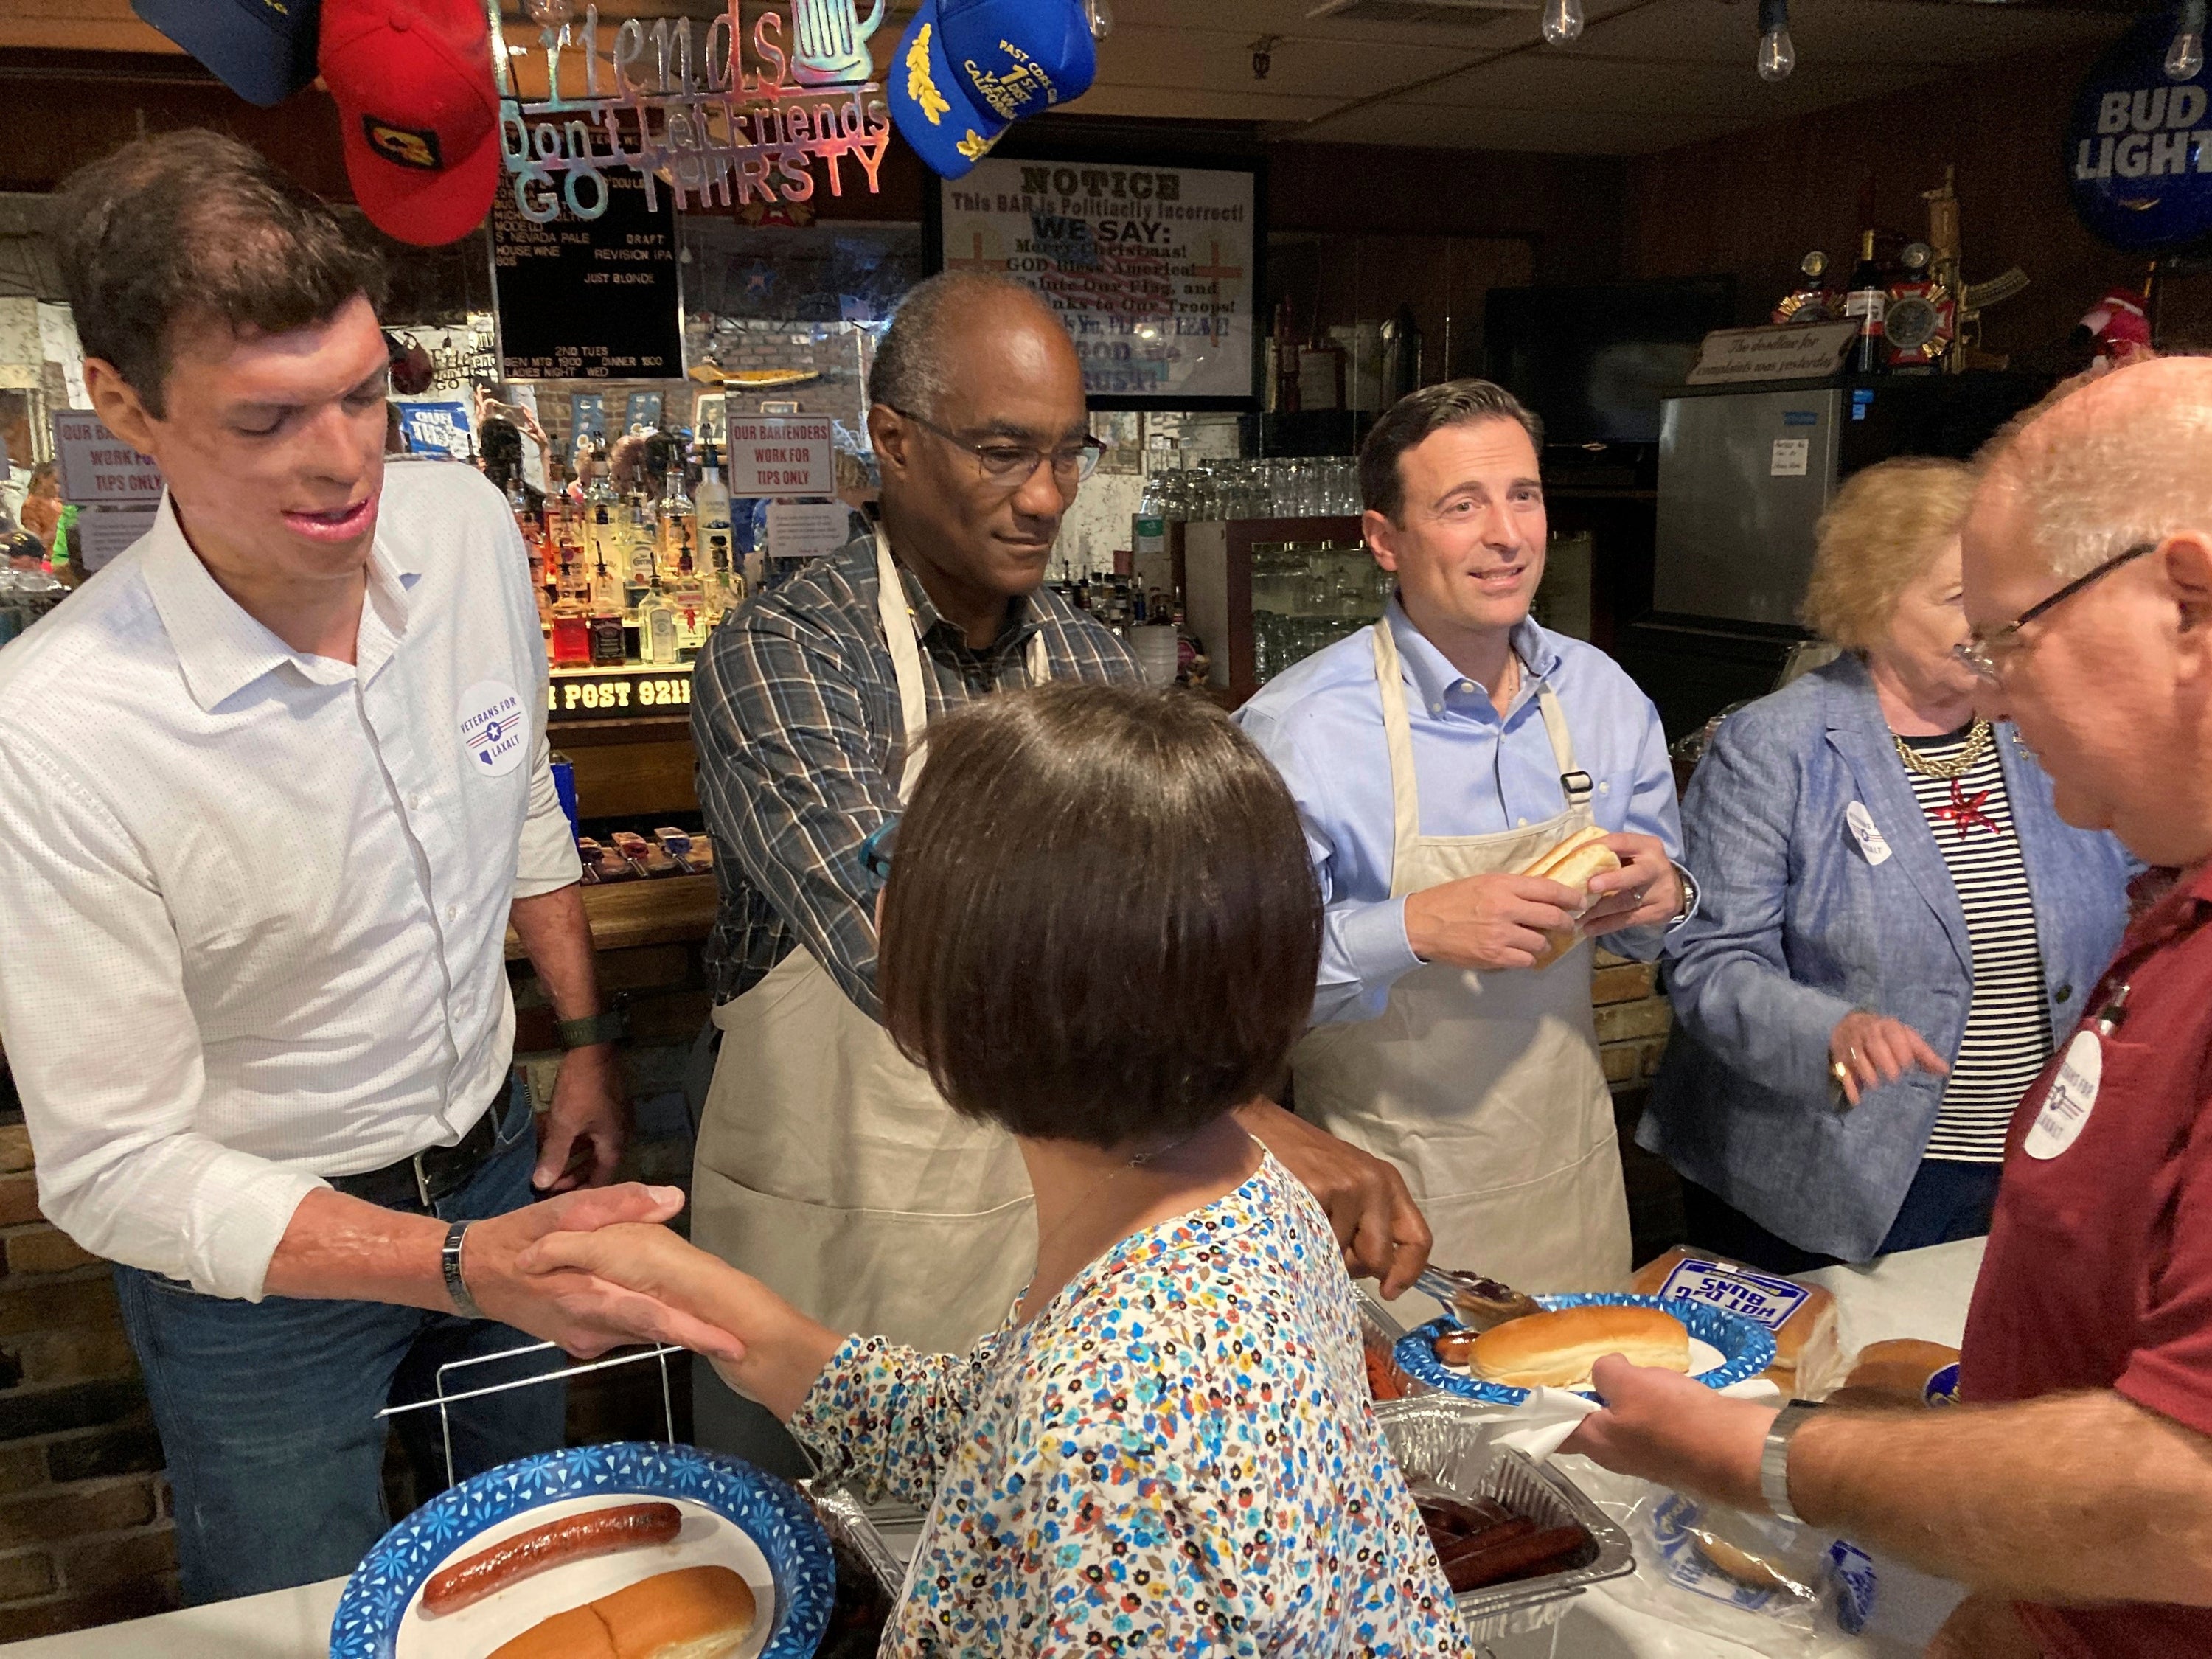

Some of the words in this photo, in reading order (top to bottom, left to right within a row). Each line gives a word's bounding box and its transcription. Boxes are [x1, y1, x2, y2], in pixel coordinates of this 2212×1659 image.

[999, 39, 1029, 63] PAST
[999, 64, 1029, 85] 1
[2097, 84, 2208, 134] BUD
[638, 103, 710, 157] Let
[726, 94, 889, 148] Friends
[2075, 129, 2212, 181] LIGHT
[515, 167, 609, 223] GO
[640, 137, 889, 213] THIRSTY
[1020, 166, 1181, 201] NOTICE
[951, 192, 990, 212] This
[997, 193, 1032, 213] BAR
[511, 232, 557, 242] NEVADA
[561, 232, 590, 243] PALE
[627, 234, 665, 245] DRAFT
[1034, 218, 1088, 241] WE
[1098, 220, 1172, 244] SAY:
[496, 245, 532, 257] HOUSE
[532, 245, 560, 257] WINE
[594, 248, 650, 260] REVISION
[654, 249, 673, 260] IPA
[1006, 257, 1048, 272] GOD
[1116, 262, 1197, 277] America!
[584, 273, 610, 283] JUST
[613, 273, 655, 284] BLONDE
[1183, 281, 1217, 295] and
[1122, 299, 1159, 312] Our
[1169, 299, 1236, 317] Troops!
[555, 347, 577, 357] 2ND
[581, 347, 609, 357] TUES
[1728, 339, 1750, 354] The
[1750, 335, 1799, 352] deadline
[1797, 332, 1820, 351] for
[505, 357, 528, 367] GEN
[531, 357, 553, 366] MTG
[558, 357, 582, 366] 1900
[602, 356, 636, 366] DINNER
[641, 356, 663, 366] 1800
[1696, 360, 1752, 376] complaints
[1754, 362, 1776, 372] was
[1777, 353, 1834, 372] yesterday
[506, 368, 540, 378] LADIES
[543, 368, 577, 378] NIGHT
[585, 367, 609, 378] WED
[62, 424, 92, 440] OUR
[734, 425, 757, 440] OUR
[760, 425, 828, 440] BARTENDERS
[90, 450, 132, 466] WORK
[754, 448, 787, 462] WORK
[789, 448, 810, 462] FOR
[95, 474, 125, 491] TIPS
[128, 473, 161, 491] ONLY
[757, 470, 780, 485] TIPS
[783, 470, 810, 484] ONLY
[564, 681, 631, 709] POST
[639, 679, 691, 706] 9211
[460, 705, 500, 734] VETERANS
[499, 696, 517, 712] FOR
[491, 734, 520, 758] LAXALT
[1699, 1277, 1767, 1305] BUNS
[1725, 1298, 1776, 1318] HOT
